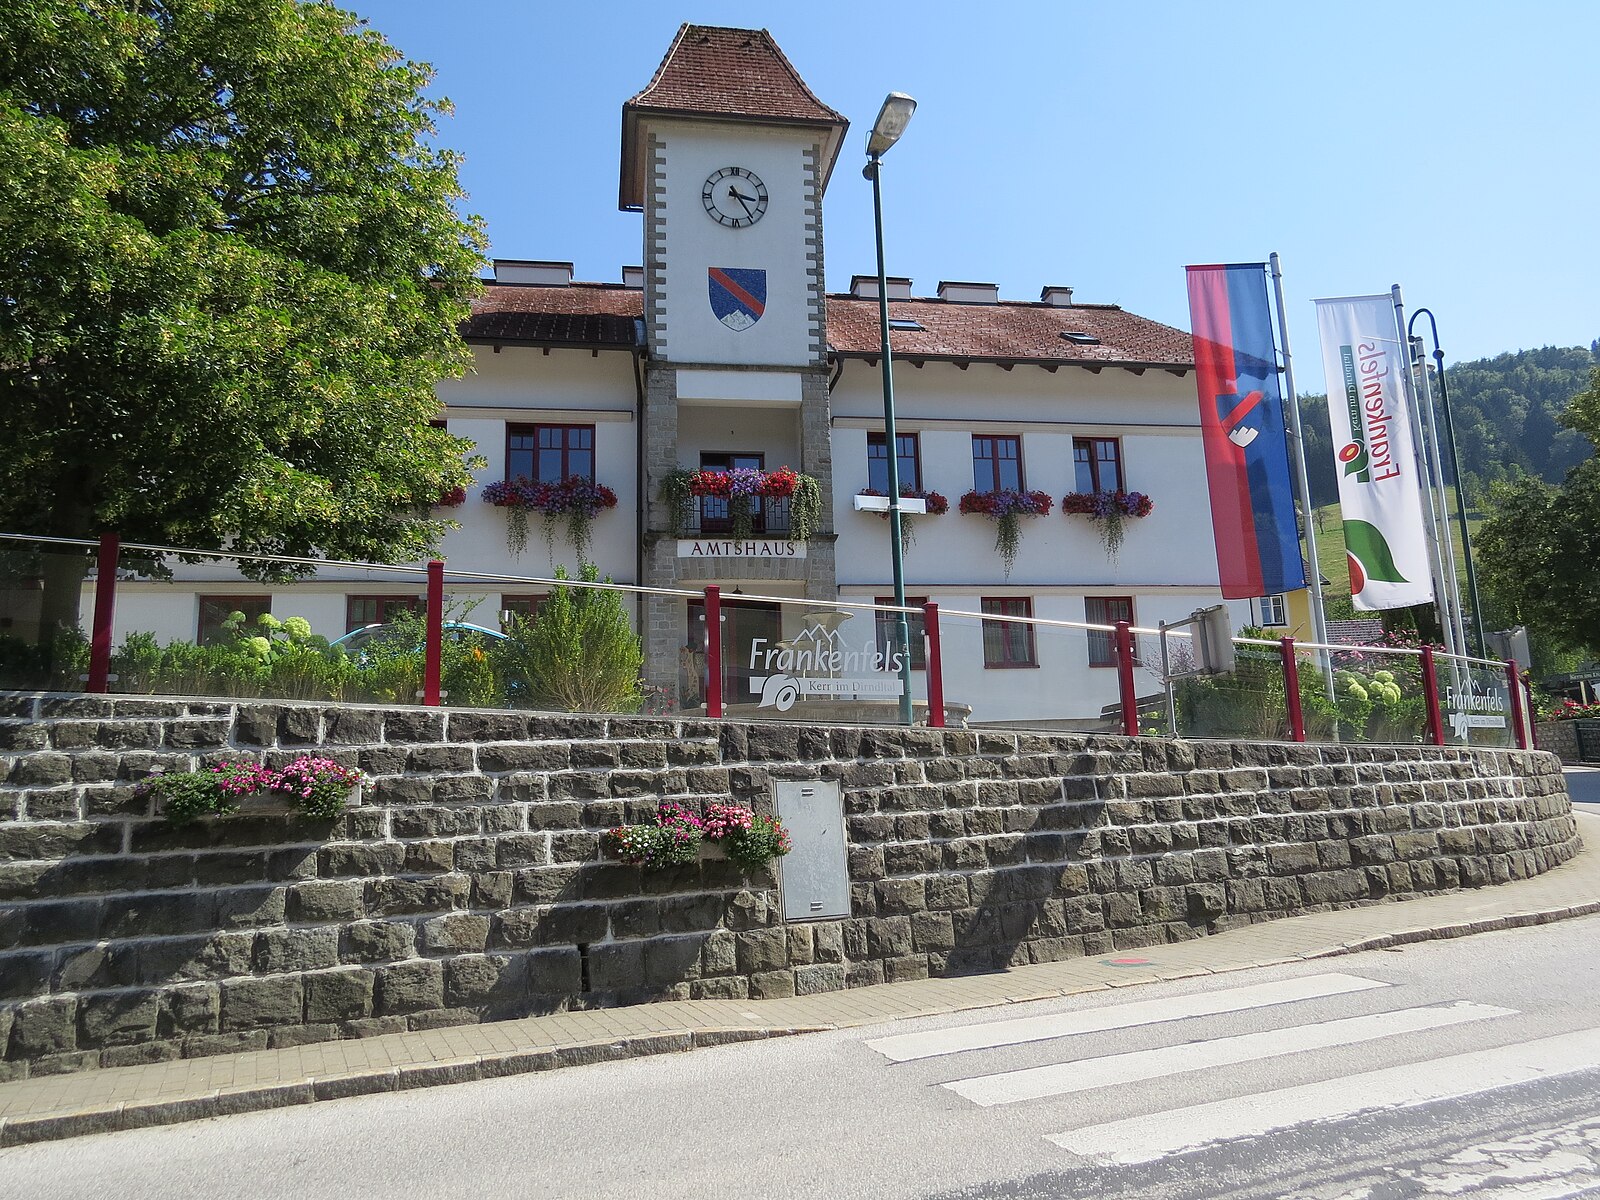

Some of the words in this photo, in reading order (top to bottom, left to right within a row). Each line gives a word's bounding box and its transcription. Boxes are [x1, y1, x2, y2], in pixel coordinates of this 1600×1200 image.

[691, 541, 796, 556] AMTSHAUS
[749, 638, 903, 673] Frankenfels
[836, 681, 849, 691] im
[1446, 686, 1503, 712] Frankenfels
